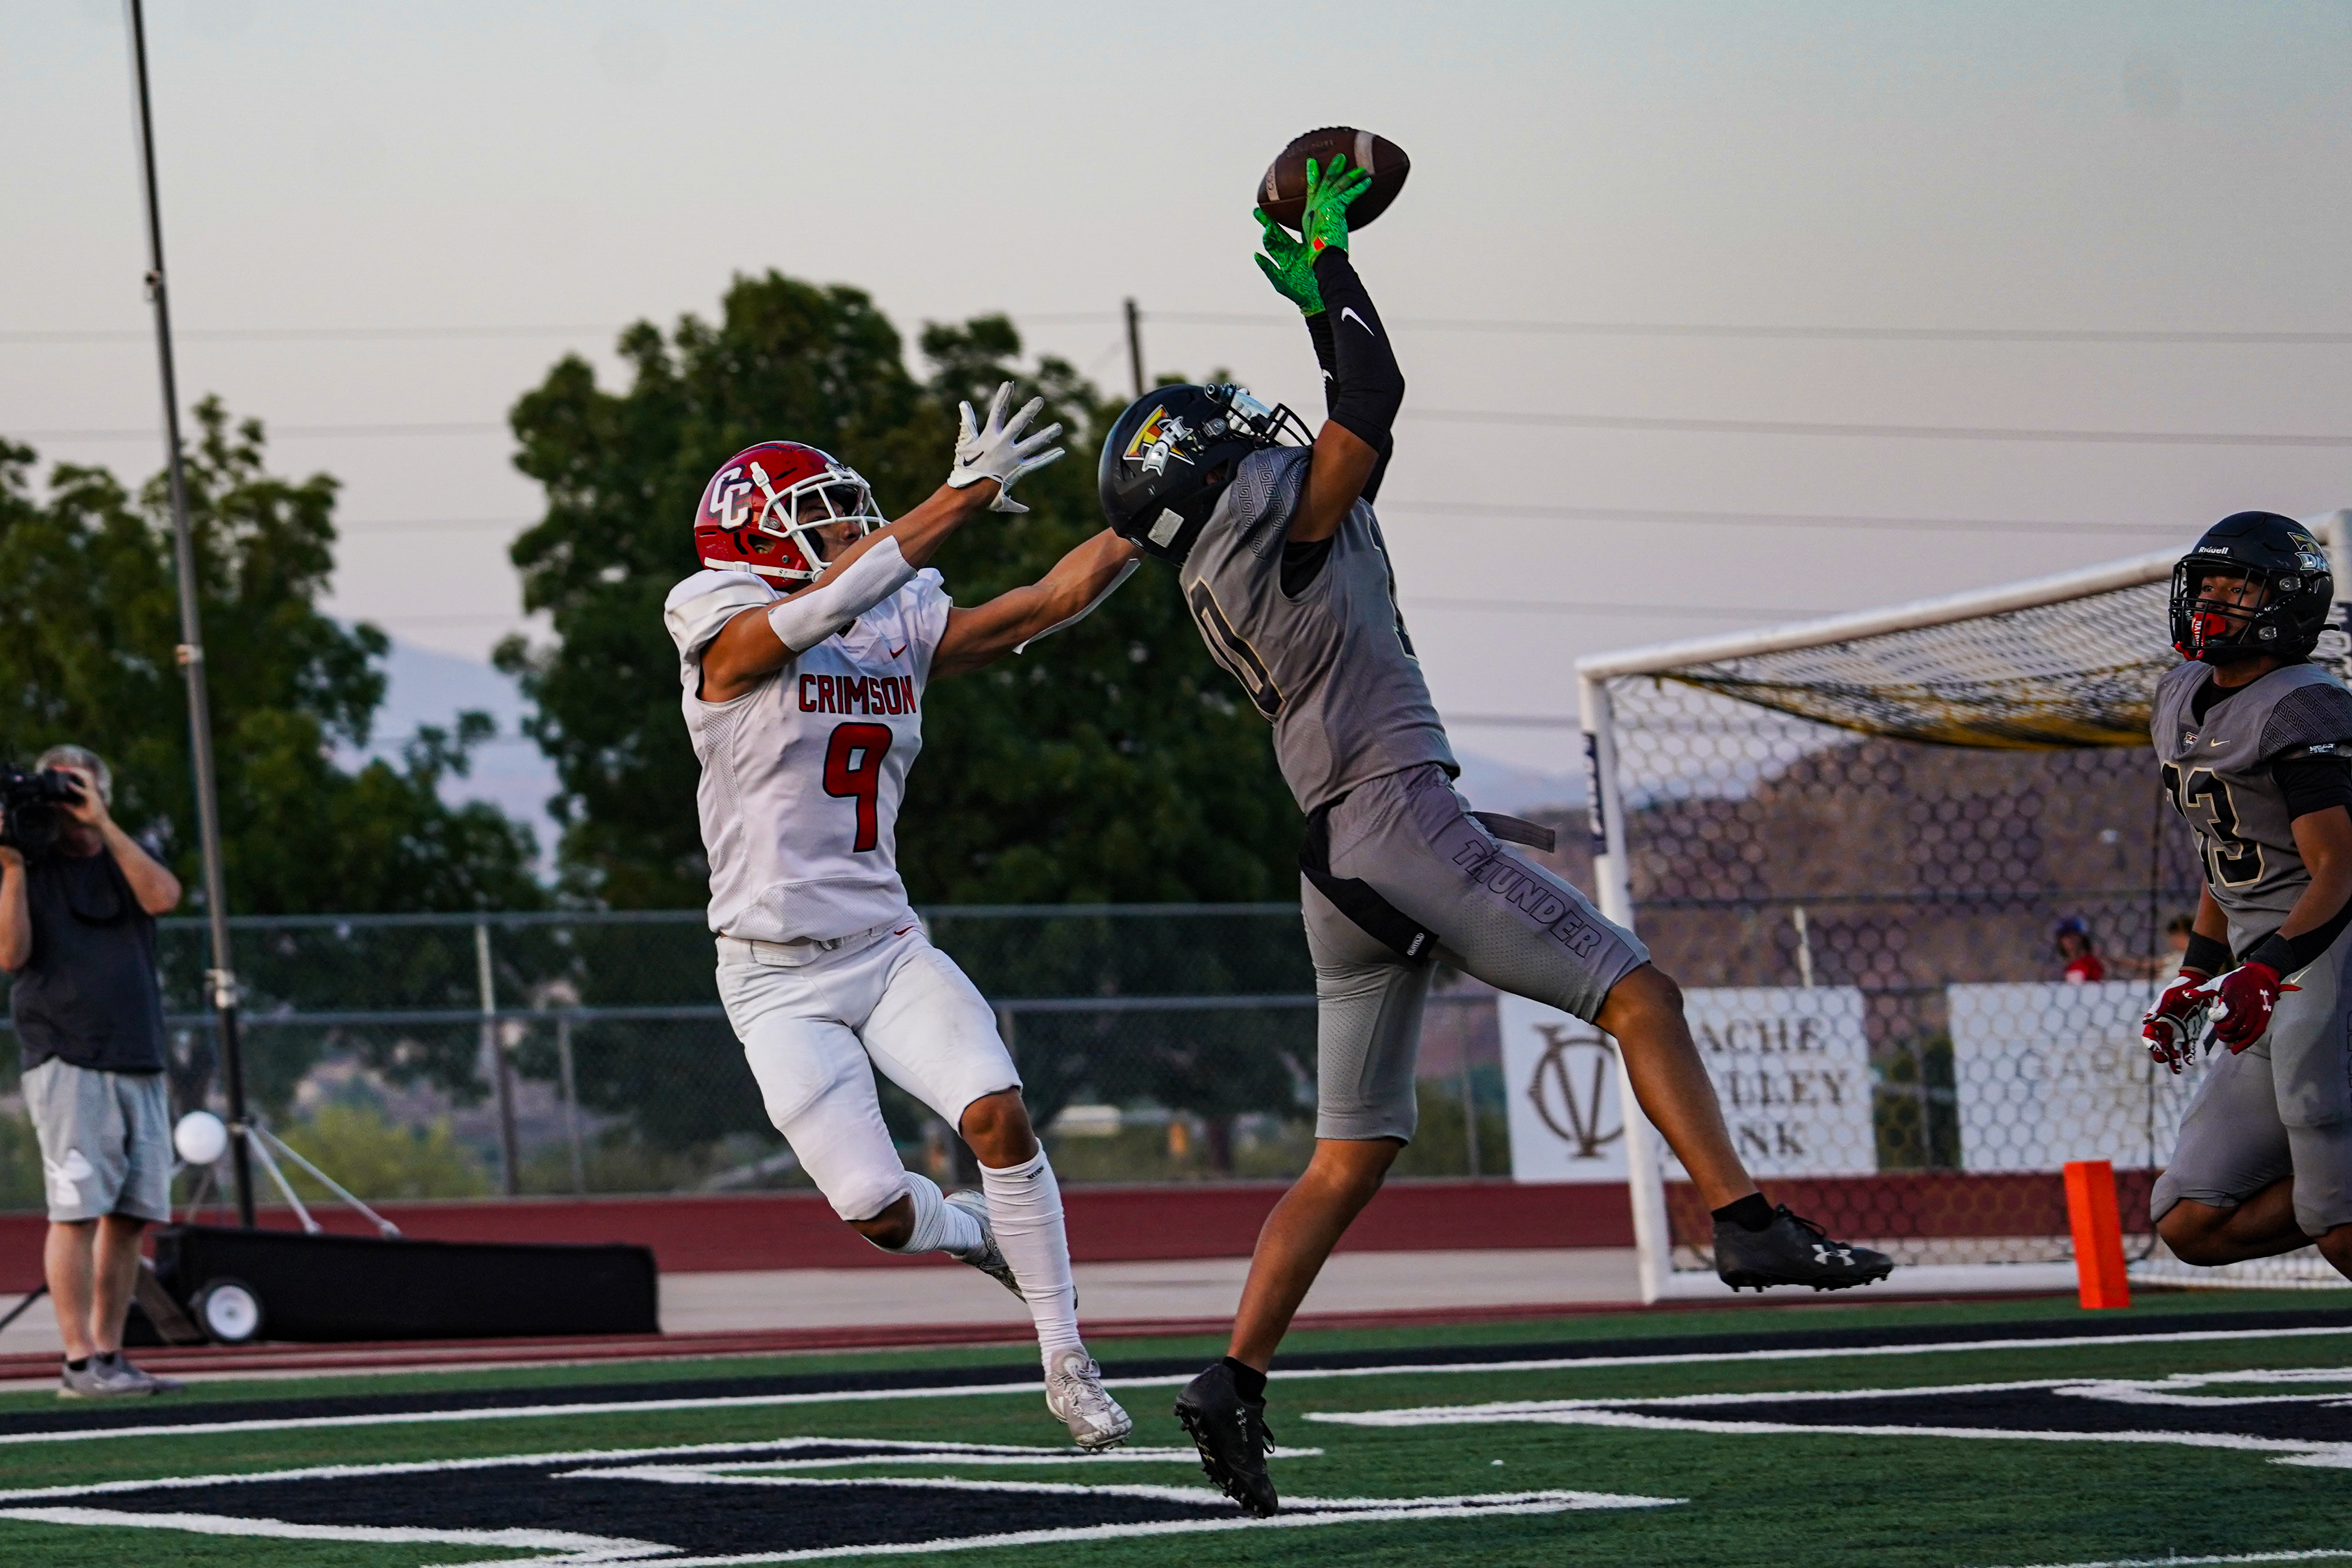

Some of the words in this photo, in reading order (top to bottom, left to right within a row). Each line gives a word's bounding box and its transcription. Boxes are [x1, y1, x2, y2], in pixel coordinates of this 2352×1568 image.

[799, 673, 916, 715] CRIMSON
[823, 721, 893, 853] 9
[1452, 840, 1602, 958] THUNDER
[1699, 1017, 1826, 1053] ACHE
